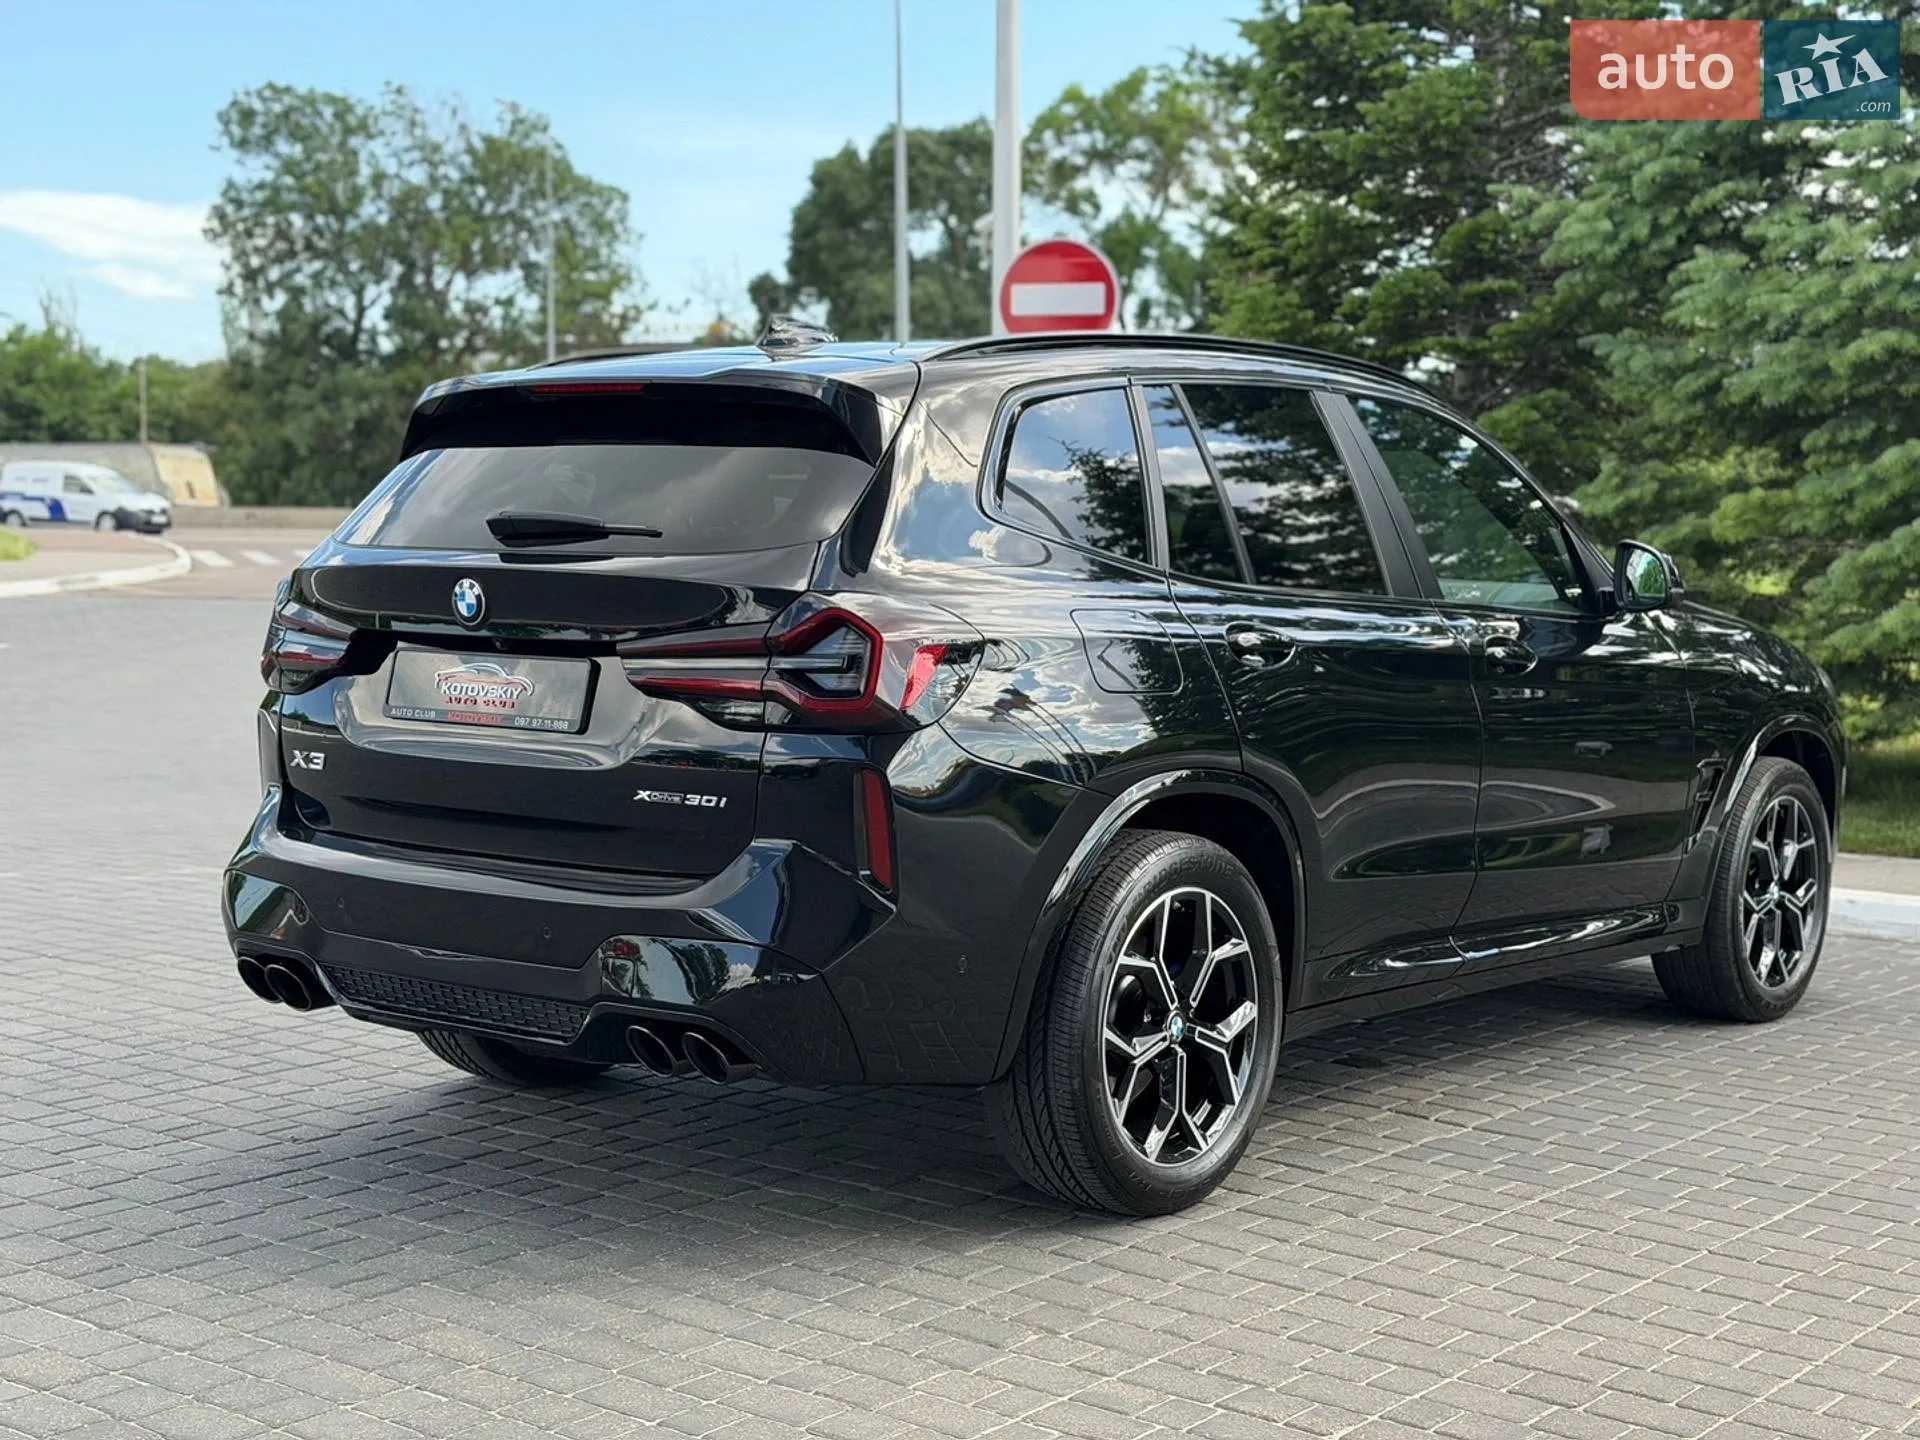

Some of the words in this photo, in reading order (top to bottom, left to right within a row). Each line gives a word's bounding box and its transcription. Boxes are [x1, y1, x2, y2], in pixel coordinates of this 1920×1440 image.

[441, 682, 522, 699] KOTOVSKIY
[445, 696, 478, 706] AUTO
[483, 699, 516, 709] CLUB
[391, 707, 413, 716] AUTO
[414, 709, 436, 719] CLUB
[290, 750, 325, 770] X3
